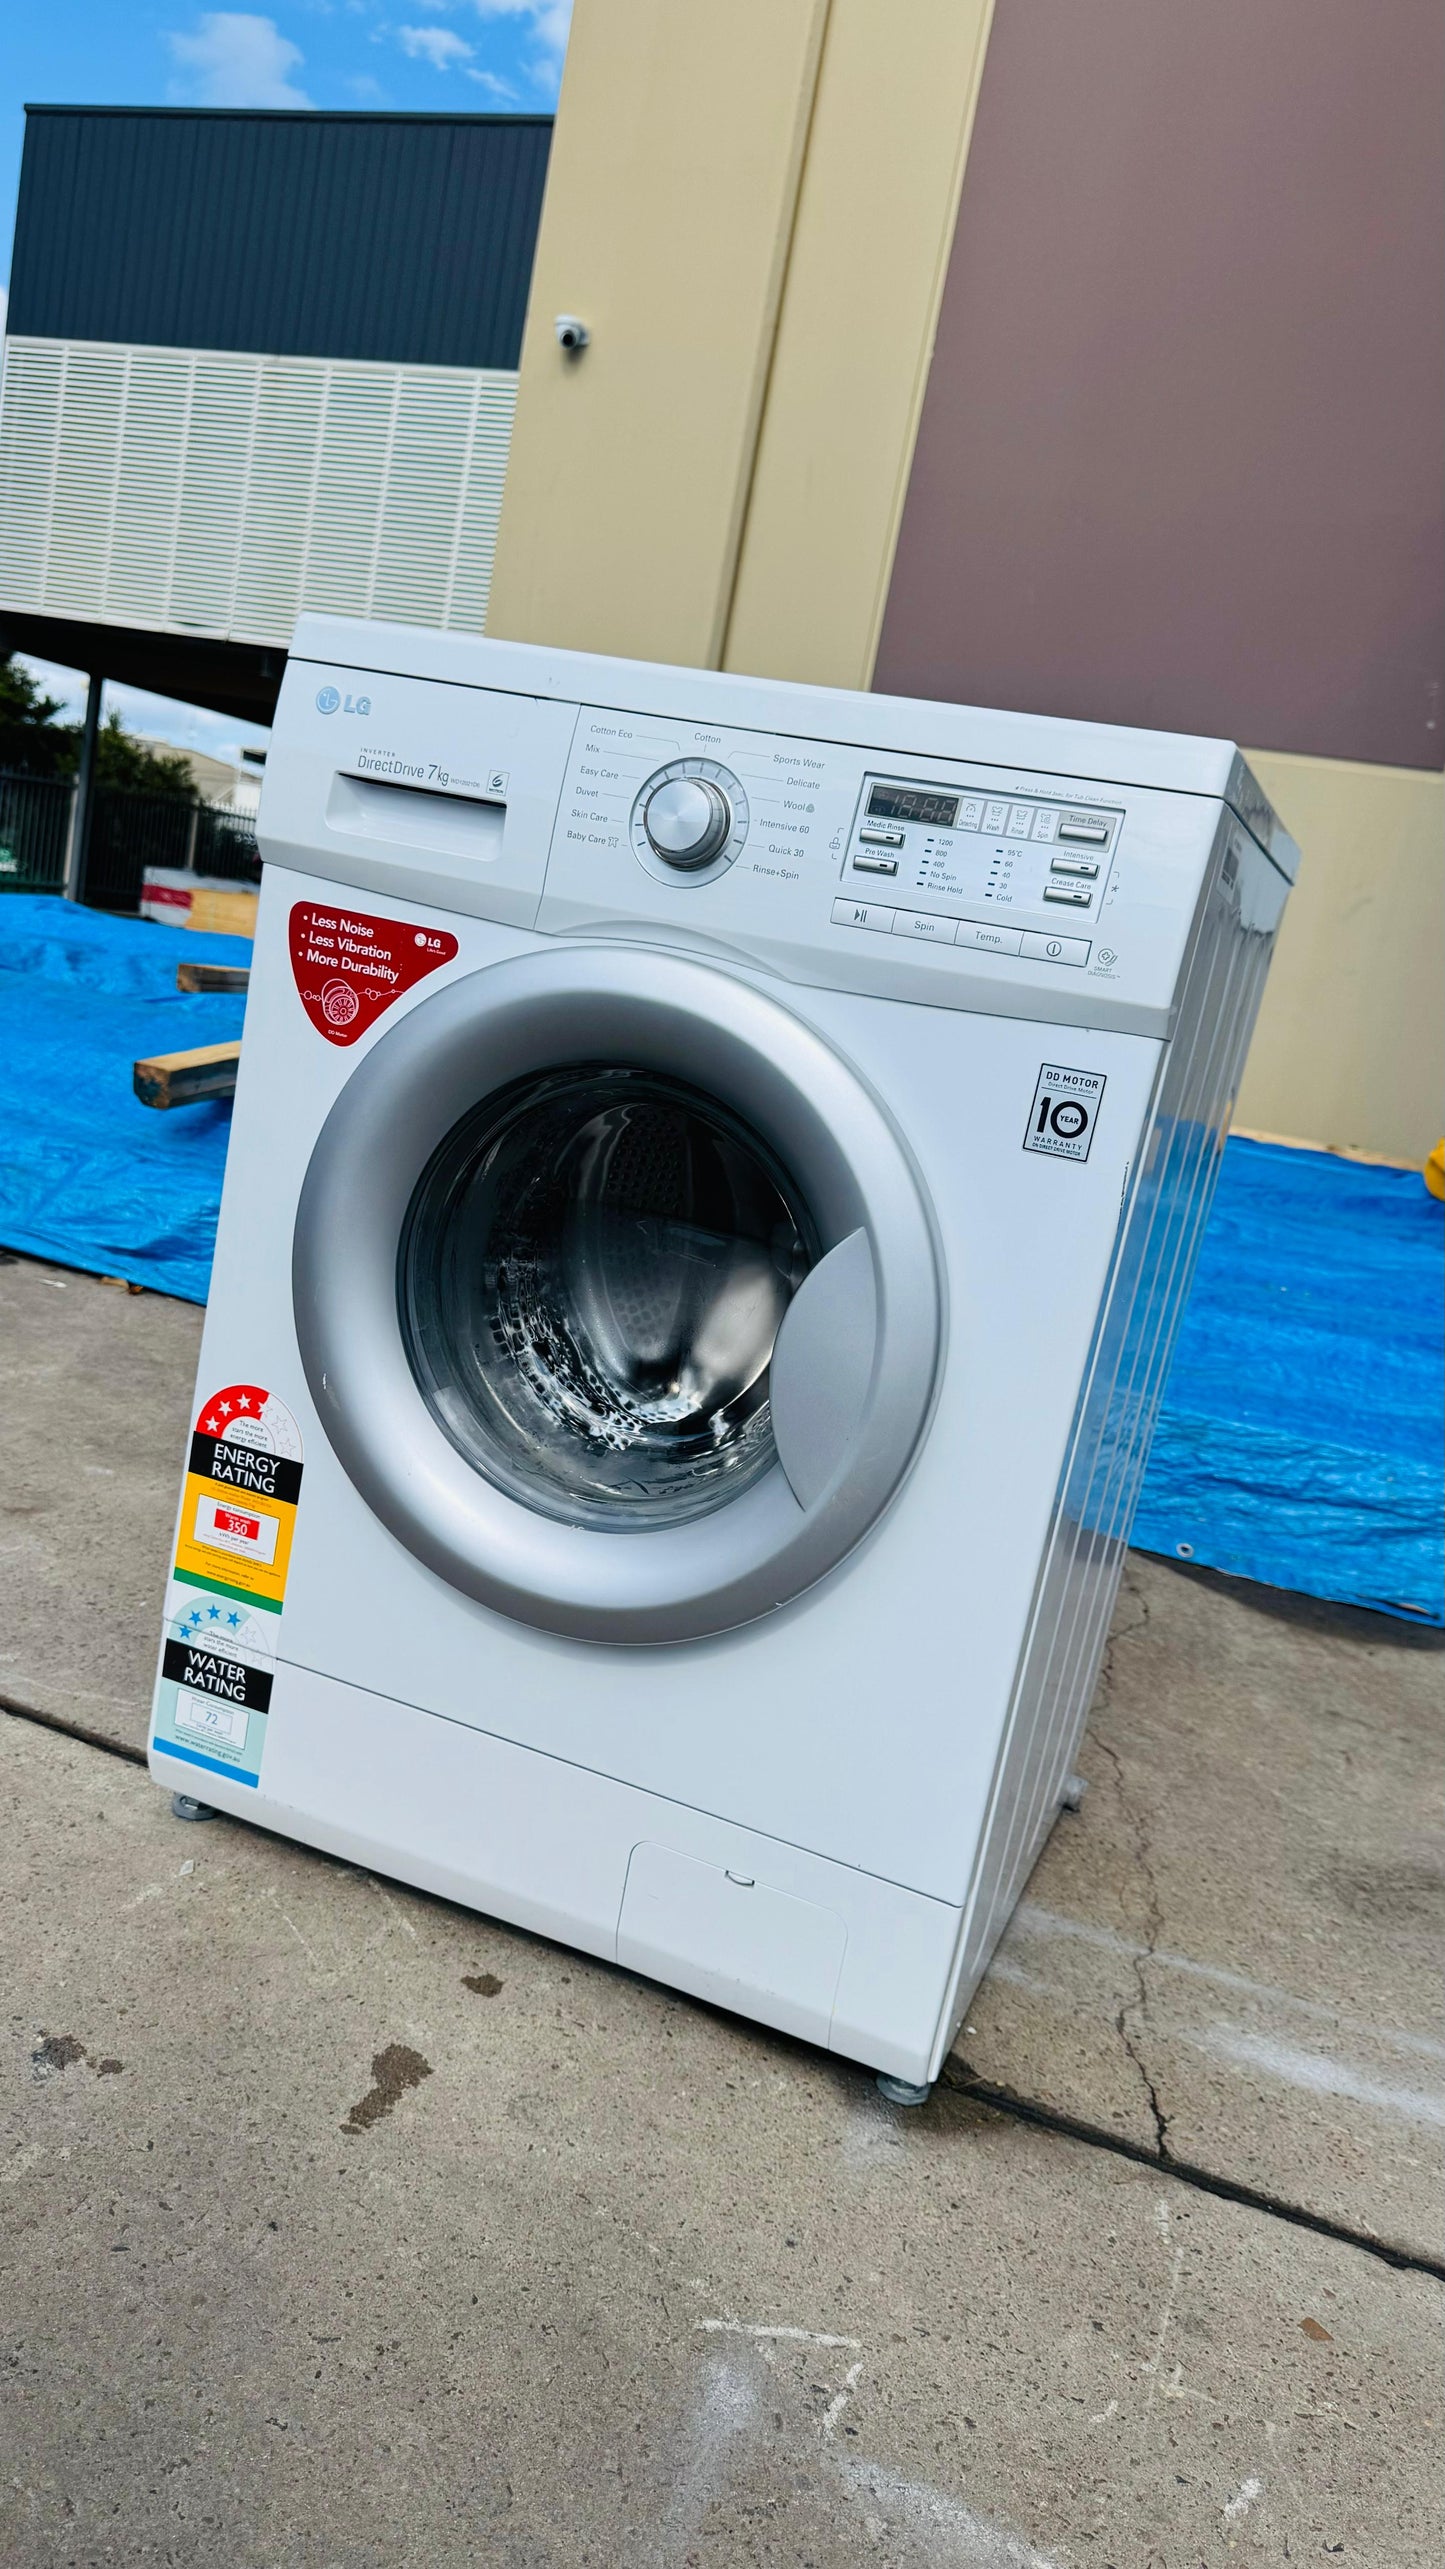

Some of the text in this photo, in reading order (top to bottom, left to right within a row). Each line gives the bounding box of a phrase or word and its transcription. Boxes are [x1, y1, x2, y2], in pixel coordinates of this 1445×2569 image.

[343, 694, 372, 715] LG
[590, 725, 633, 739] Cotton Eco
[694, 732, 722, 744] Cotton
[360, 747, 396, 757] INVERTER
[585, 744, 600, 753] Mix
[773, 754, 825, 769] Sports Wear
[580, 766, 619, 780] Easy Care
[787, 777, 821, 790] Delicate
[575, 786, 599, 798] Duvet
[783, 800, 806, 812] Wool
[571, 809, 608, 823] Skin Care
[1069, 815, 1108, 828] Time Delay
[759, 819, 810, 834] Intensive 60
[867, 820, 905, 831] Medic Rinse
[986, 823, 1000, 831] Wash
[566, 830, 606, 845] Baby Care
[1037, 831, 1049, 839] Spin
[939, 838, 953, 847] 1200
[768, 844, 804, 858] Quick 30
[877, 850, 895, 858] Wash
[935, 849, 948, 857] 800
[1063, 850, 1094, 861] Intensive
[933, 860, 945, 868] 400
[753, 864, 800, 880] Rinse+Spin
[941, 873, 957, 881] Spin
[927, 882, 963, 894] Rinse Hold
[1051, 877, 1092, 890] Crease Care
[996, 893, 1013, 902] Cold
[311, 912, 374, 938] Less Noise
[914, 920, 935, 932] Spin
[427, 937, 441, 949] LG
[976, 931, 1003, 944] Temp.
[309, 931, 392, 961] Less Vibration
[306, 949, 400, 985] More Durability
[1046, 1071, 1099, 1089] DD MOTOR
[1037, 1096, 1088, 1139] 10
[1060, 1115, 1079, 1125] YEAR
[1034, 1135, 1082, 1151] WARRANTY
[240, 1420, 264, 1432] The more
[230, 1433, 246, 1443] energy
[214, 1443, 280, 1476] ENERGY
[211, 1461, 275, 1493] RATING
[228, 1519, 248, 1536] 350
[189, 1649, 246, 1684] WATER
[184, 1666, 246, 1701] RATING
[206, 1711, 218, 1725] 72
